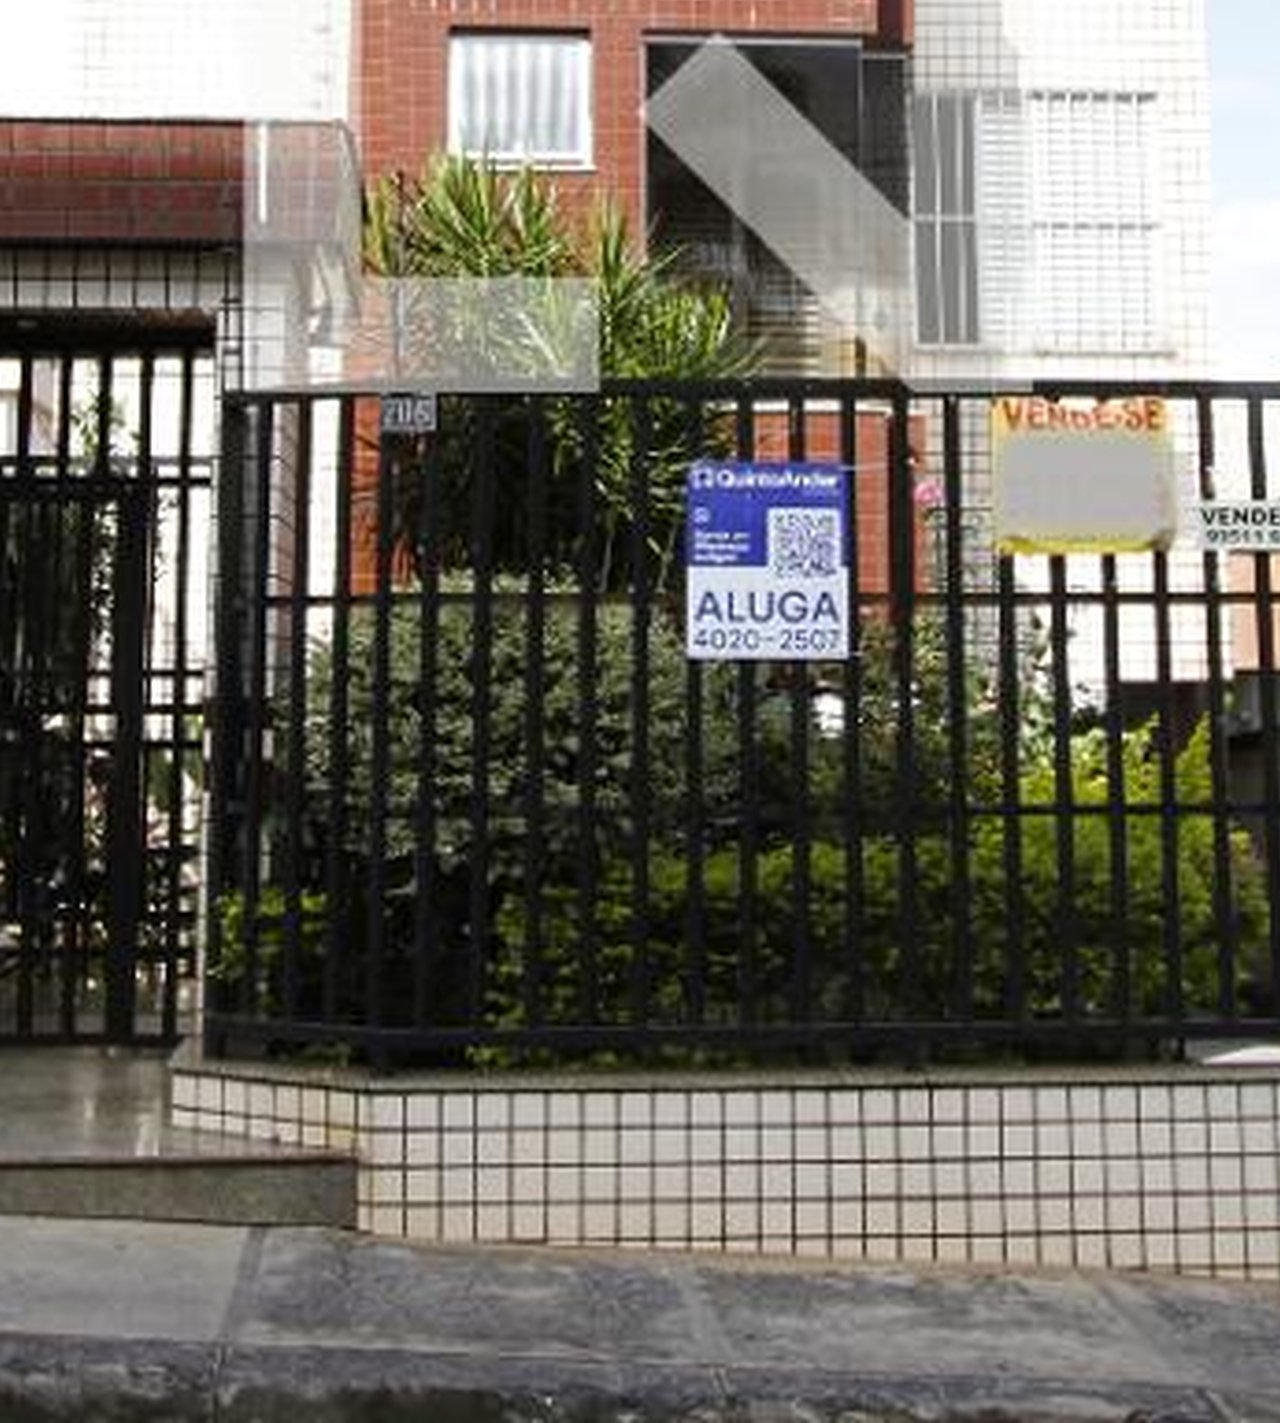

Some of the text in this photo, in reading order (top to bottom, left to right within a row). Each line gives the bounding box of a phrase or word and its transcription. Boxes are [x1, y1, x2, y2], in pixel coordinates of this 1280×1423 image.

[1001, 398, 1165, 431] VENDE-SE
[695, 590, 839, 623] ALUGA
[694, 629, 839, 651] 4020-2507
